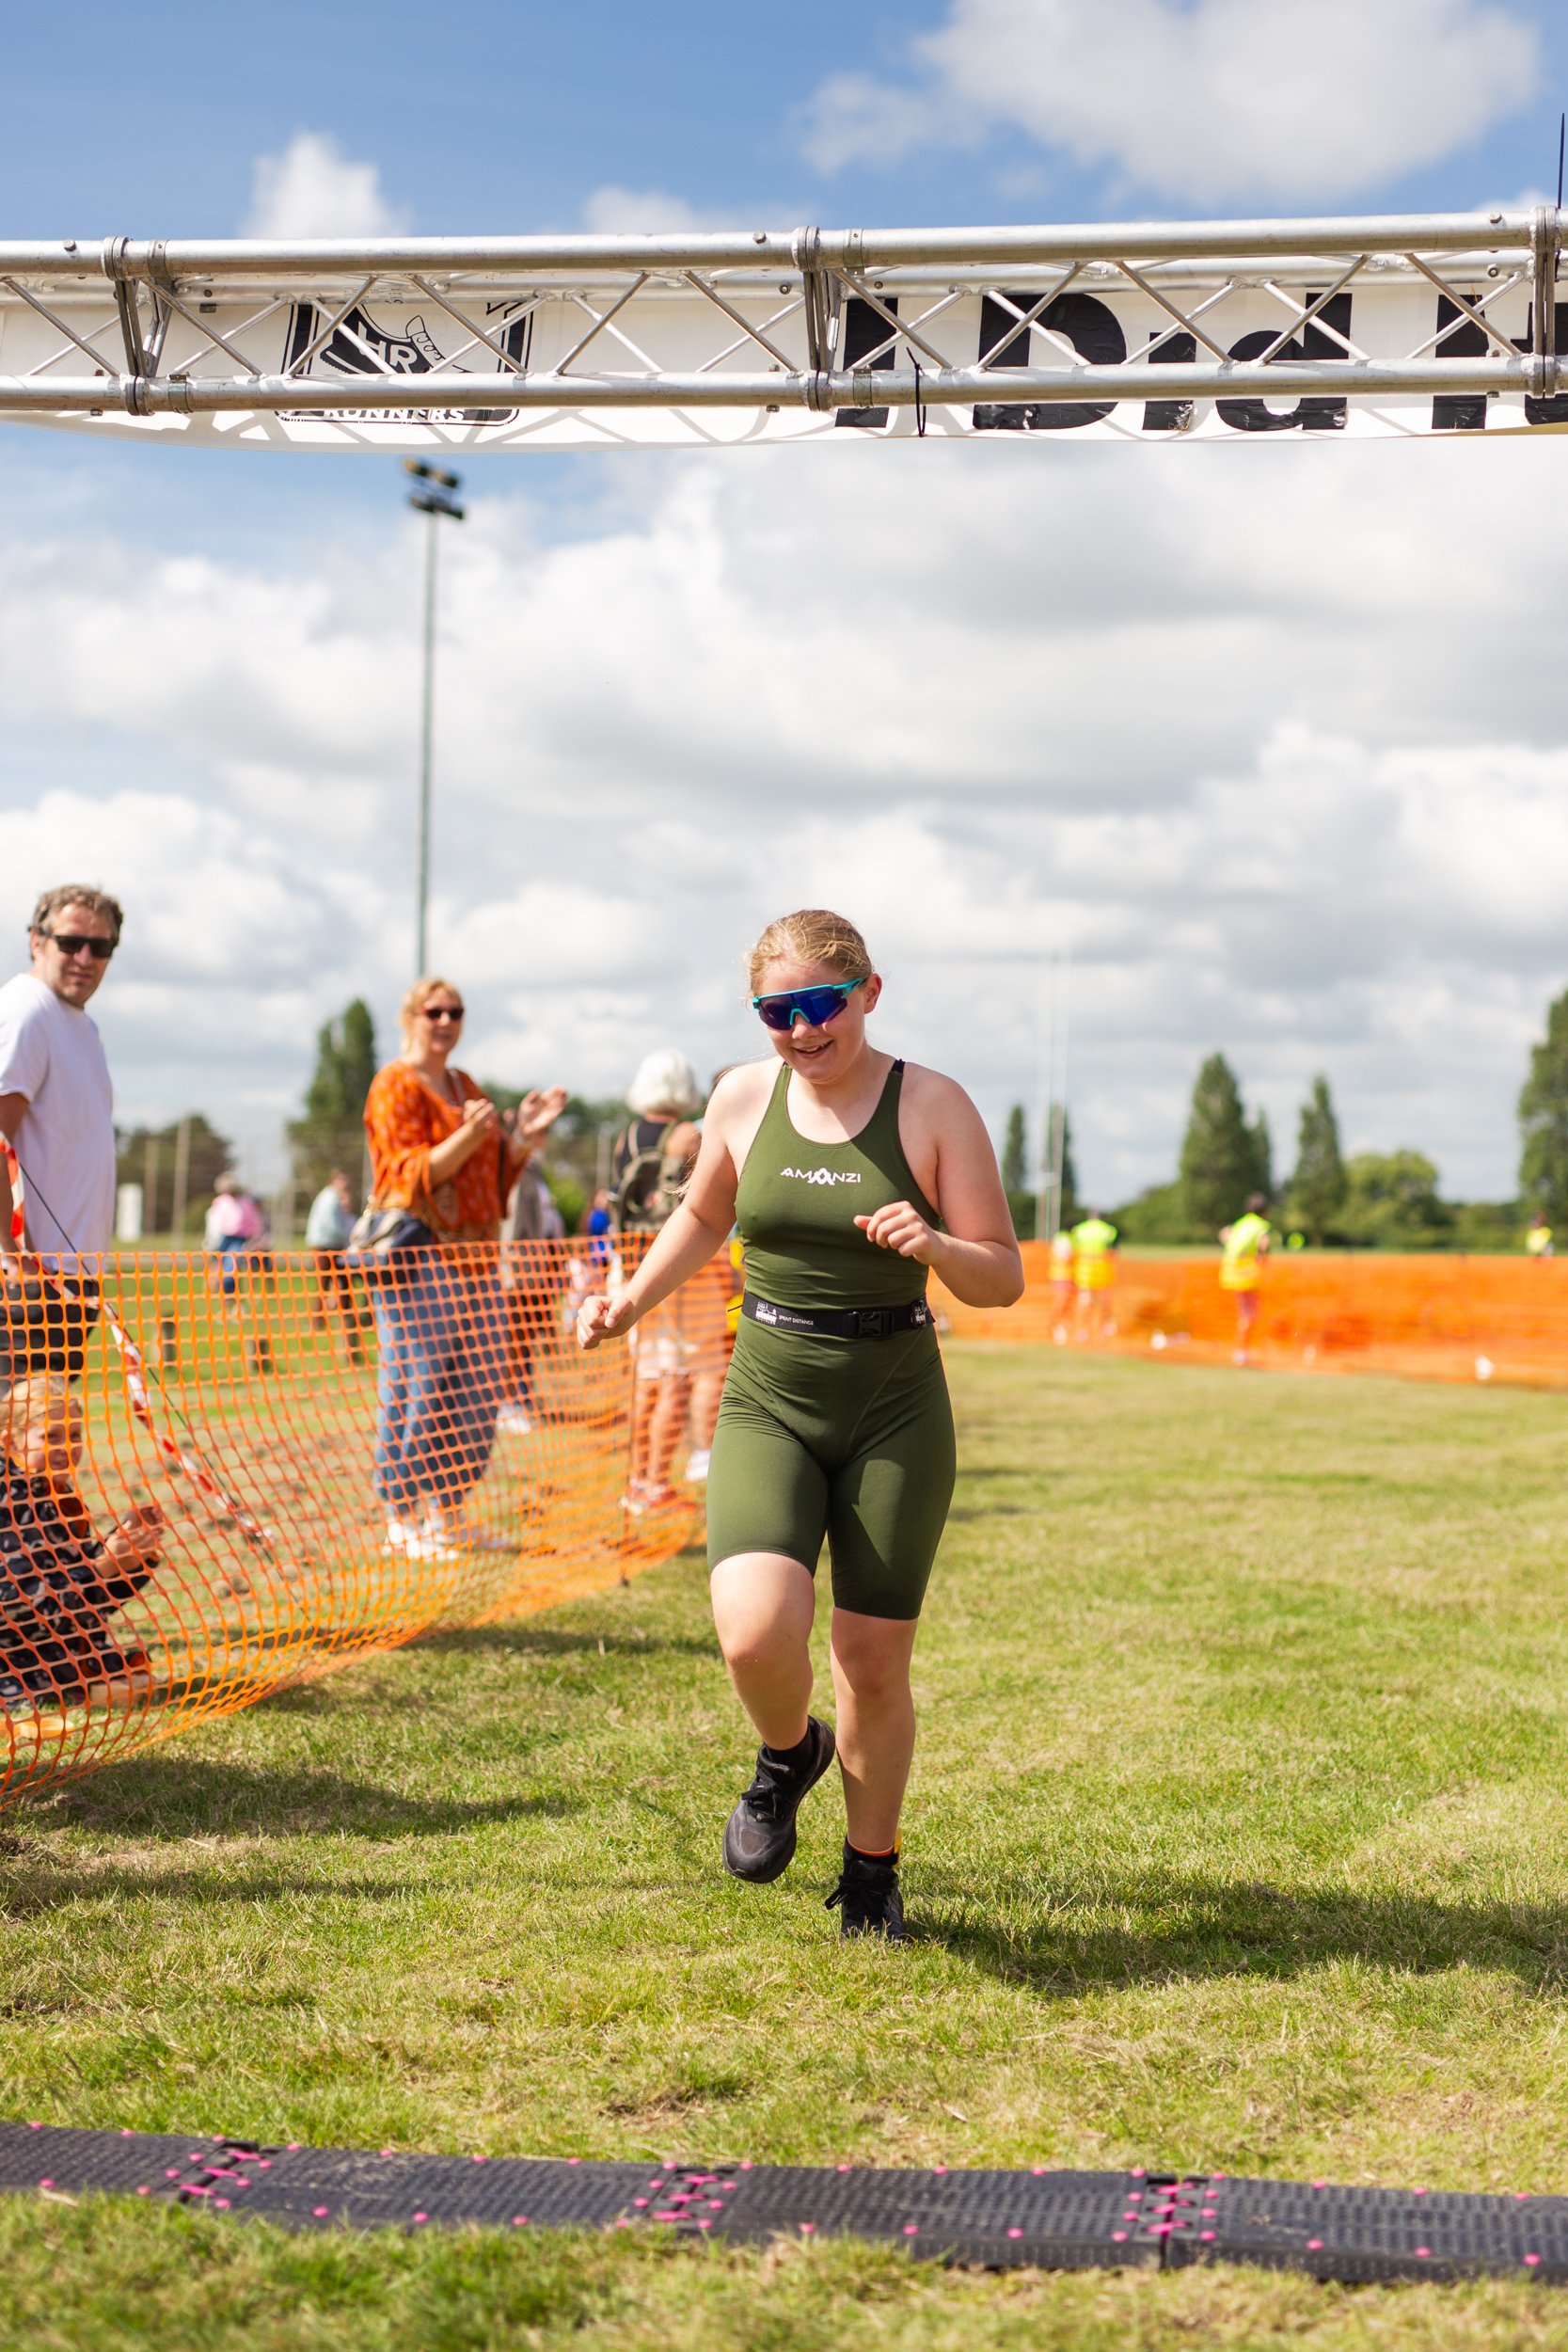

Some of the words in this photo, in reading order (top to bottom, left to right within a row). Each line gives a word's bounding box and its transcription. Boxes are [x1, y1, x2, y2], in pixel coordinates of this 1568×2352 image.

[972, 293, 1353, 432] Did
[780, 1167, 862, 1185] AMANZI
[792, 1317, 814, 1326] DISTANCE
